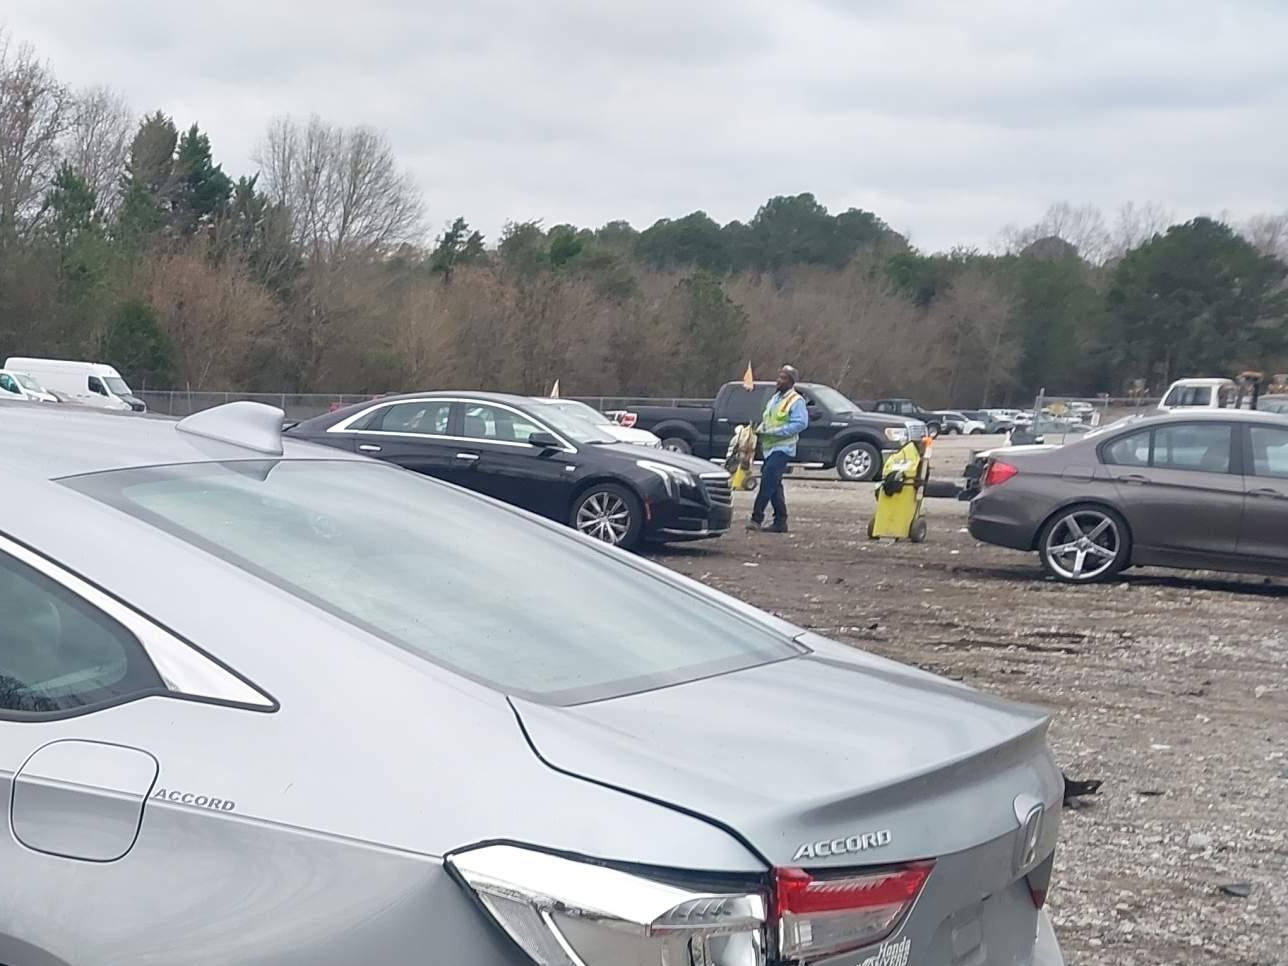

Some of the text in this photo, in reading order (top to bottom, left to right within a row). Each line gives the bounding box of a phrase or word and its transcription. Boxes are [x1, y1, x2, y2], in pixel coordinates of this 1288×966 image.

[154, 788, 236, 811] ACCORD
[792, 829, 892, 861] ACCORD
[875, 936, 911, 959] Honda
